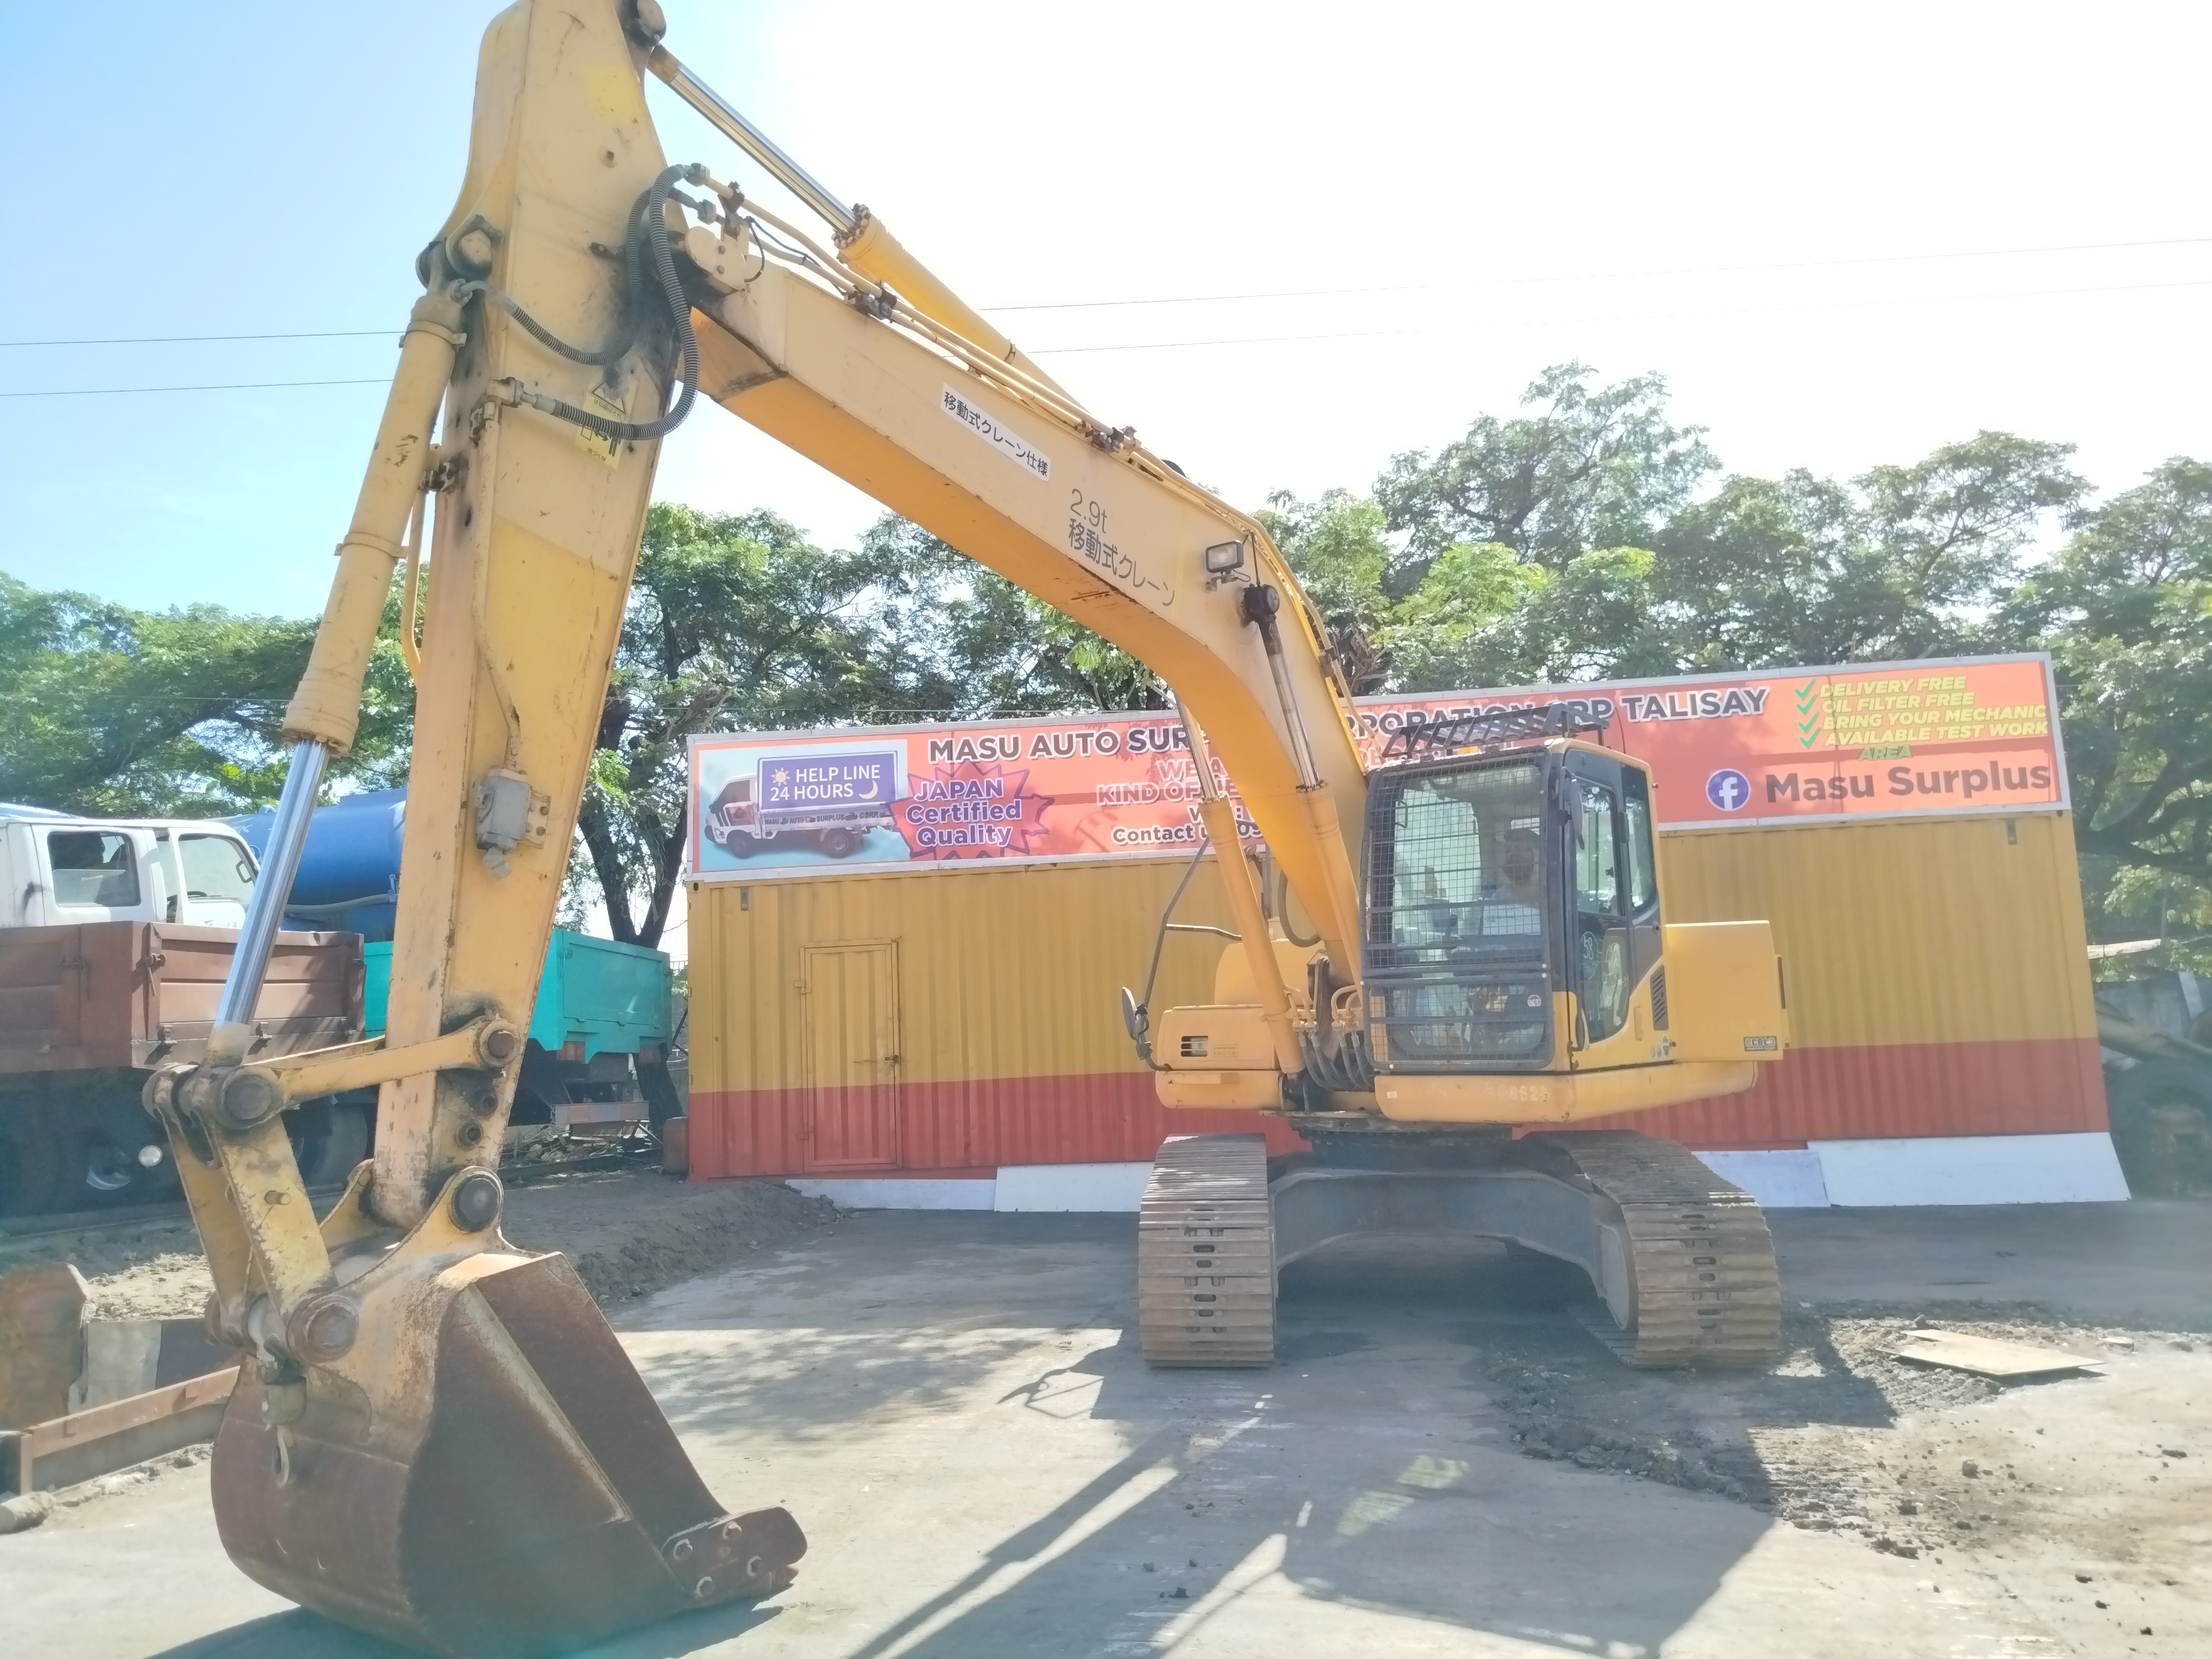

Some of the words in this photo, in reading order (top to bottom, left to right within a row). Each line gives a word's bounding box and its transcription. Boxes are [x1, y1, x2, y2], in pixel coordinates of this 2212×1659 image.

[944, 391, 1049, 477] 移動式クレーン仕様
[1070, 488, 1108, 534] 2.9t
[1068, 518, 1176, 607] 移動式クレーン
[1819, 678, 1913, 699] DELIVERY
[1916, 675, 1968, 693] FREE
[1822, 698, 1853, 714] OIL
[1856, 695, 1922, 713] FILTER
[1924, 692, 1976, 708] FREE
[929, 737, 1020, 763] MASU
[1029, 731, 1120, 759] AUTO
[1619, 686, 1770, 722] TALISAY
[1822, 713, 1883, 732] BRING
[1887, 710, 1941, 728] YOUR
[1943, 704, 2047, 724] MECHANIC
[1824, 726, 1931, 748] AVAILABLE
[1936, 723, 1985, 741] TEST
[1988, 719, 2049, 738] WORK
[1858, 744, 1913, 761] AREA
[796, 766, 839, 783] HELP
[844, 765, 881, 780] LINE
[1766, 773, 1875, 804] Masu
[1888, 760, 2052, 799] Surplus
[770, 786, 790, 802] 24
[794, 782, 854, 801] HOURS
[914, 778, 1004, 801] JAPAN
[1096, 780, 1159, 806] KIND
[1164, 778, 1201, 802] OF
[816, 814, 845, 822] SURPLUS
[905, 800, 1021, 825] Certified
[917, 822, 1013, 847] Quality
[1111, 823, 1195, 846] Contact
